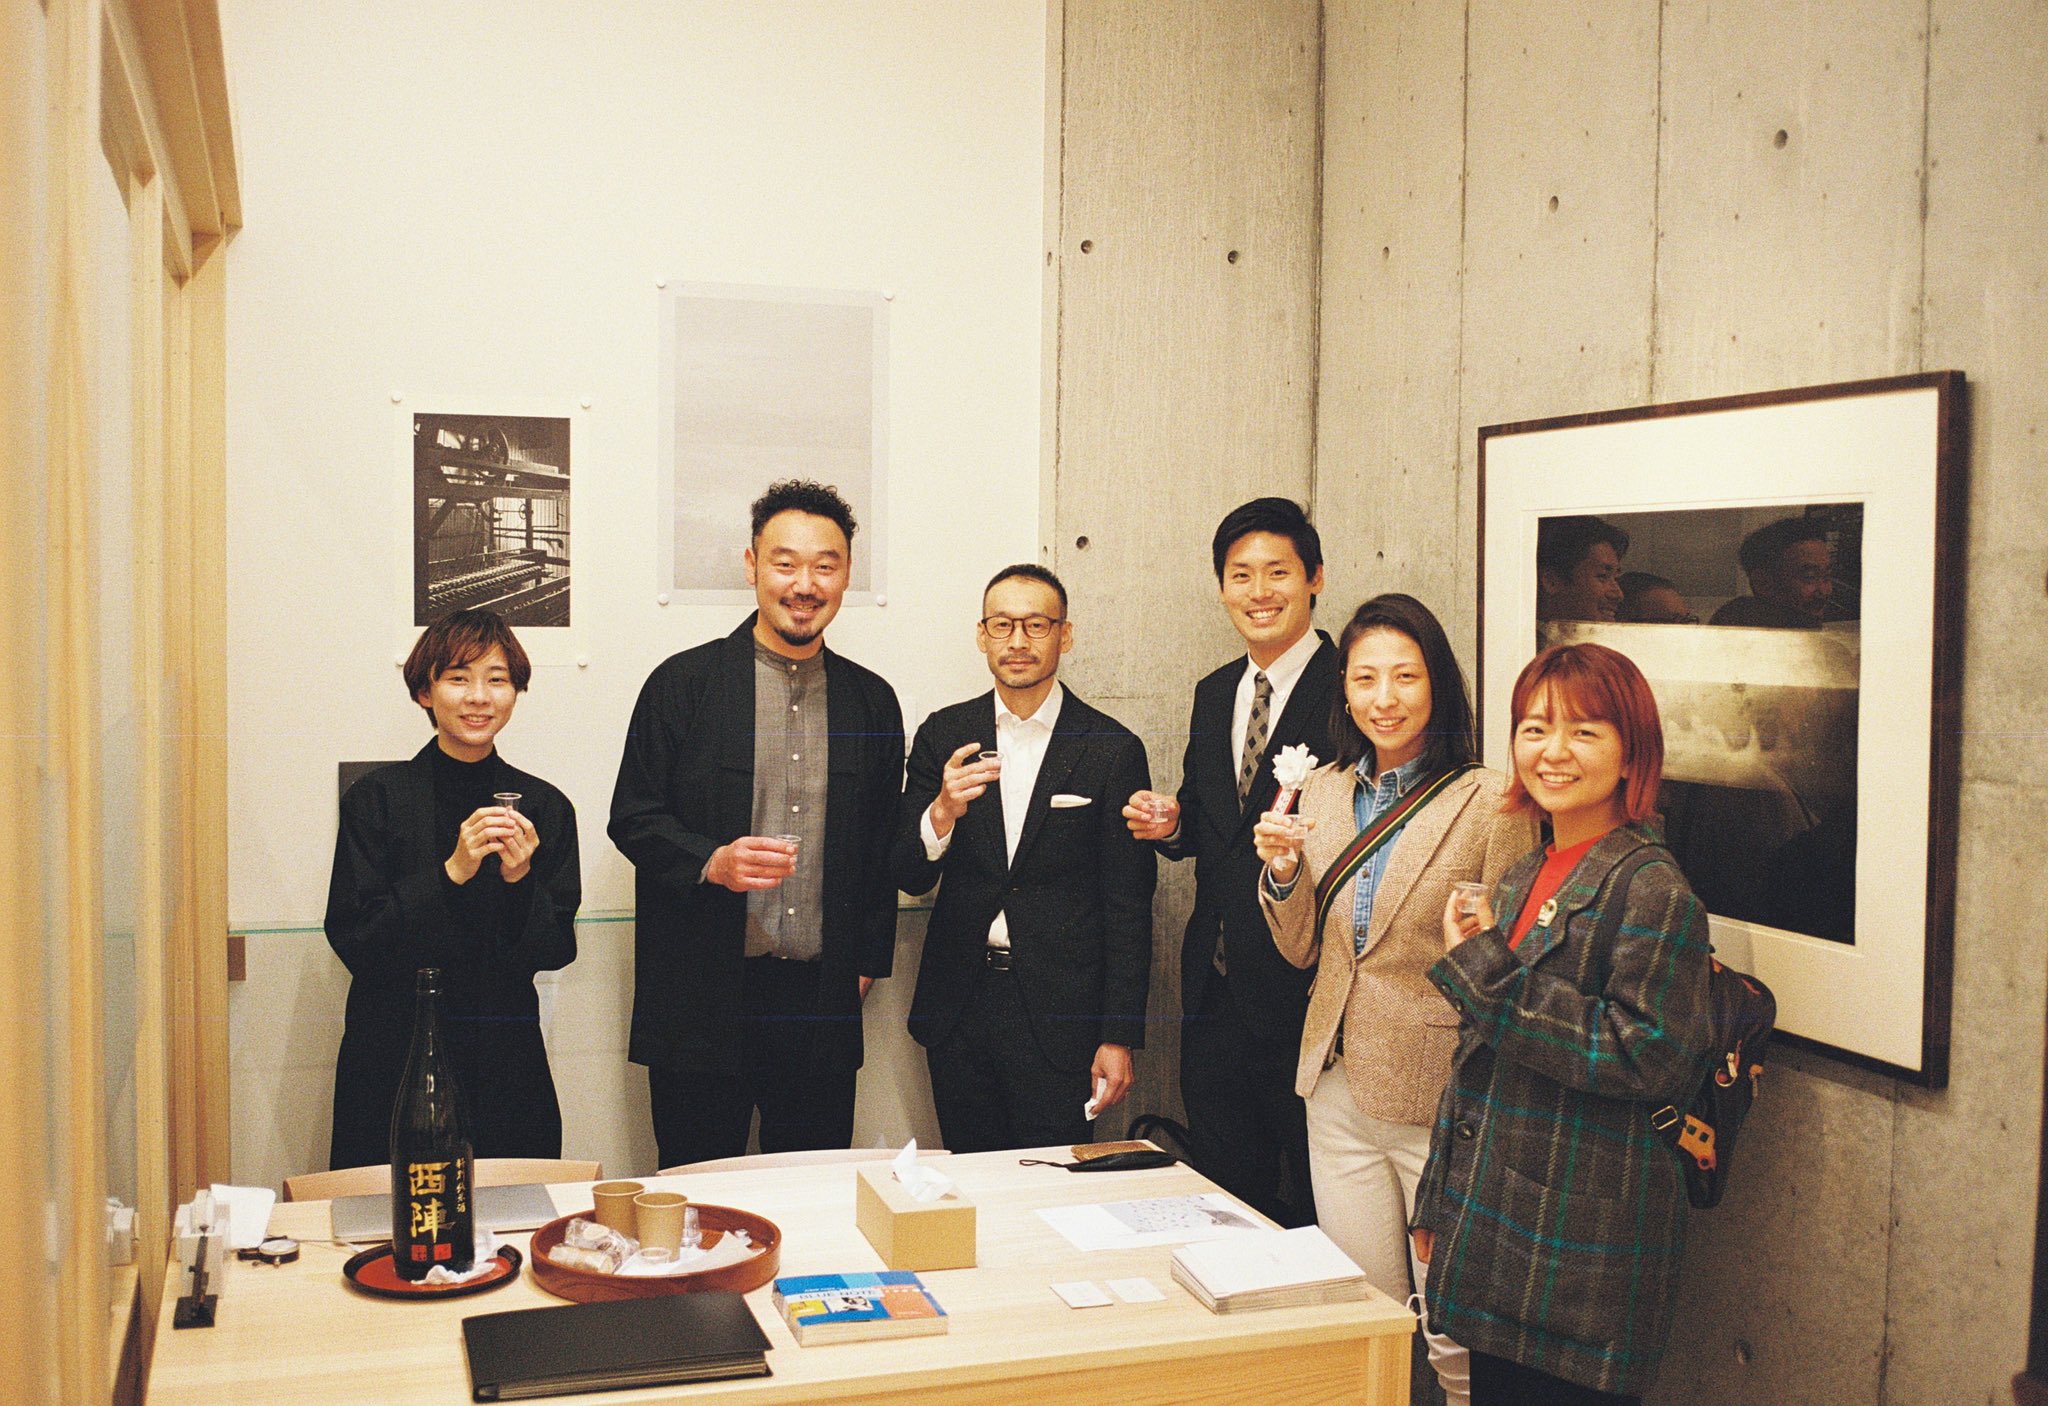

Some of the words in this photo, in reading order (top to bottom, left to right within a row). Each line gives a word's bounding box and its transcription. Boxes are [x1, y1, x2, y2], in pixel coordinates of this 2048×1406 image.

[408, 1162, 456, 1243] 西陣
[799, 1291, 836, 1300] BLUE
[839, 1289, 876, 1298] NOTE
